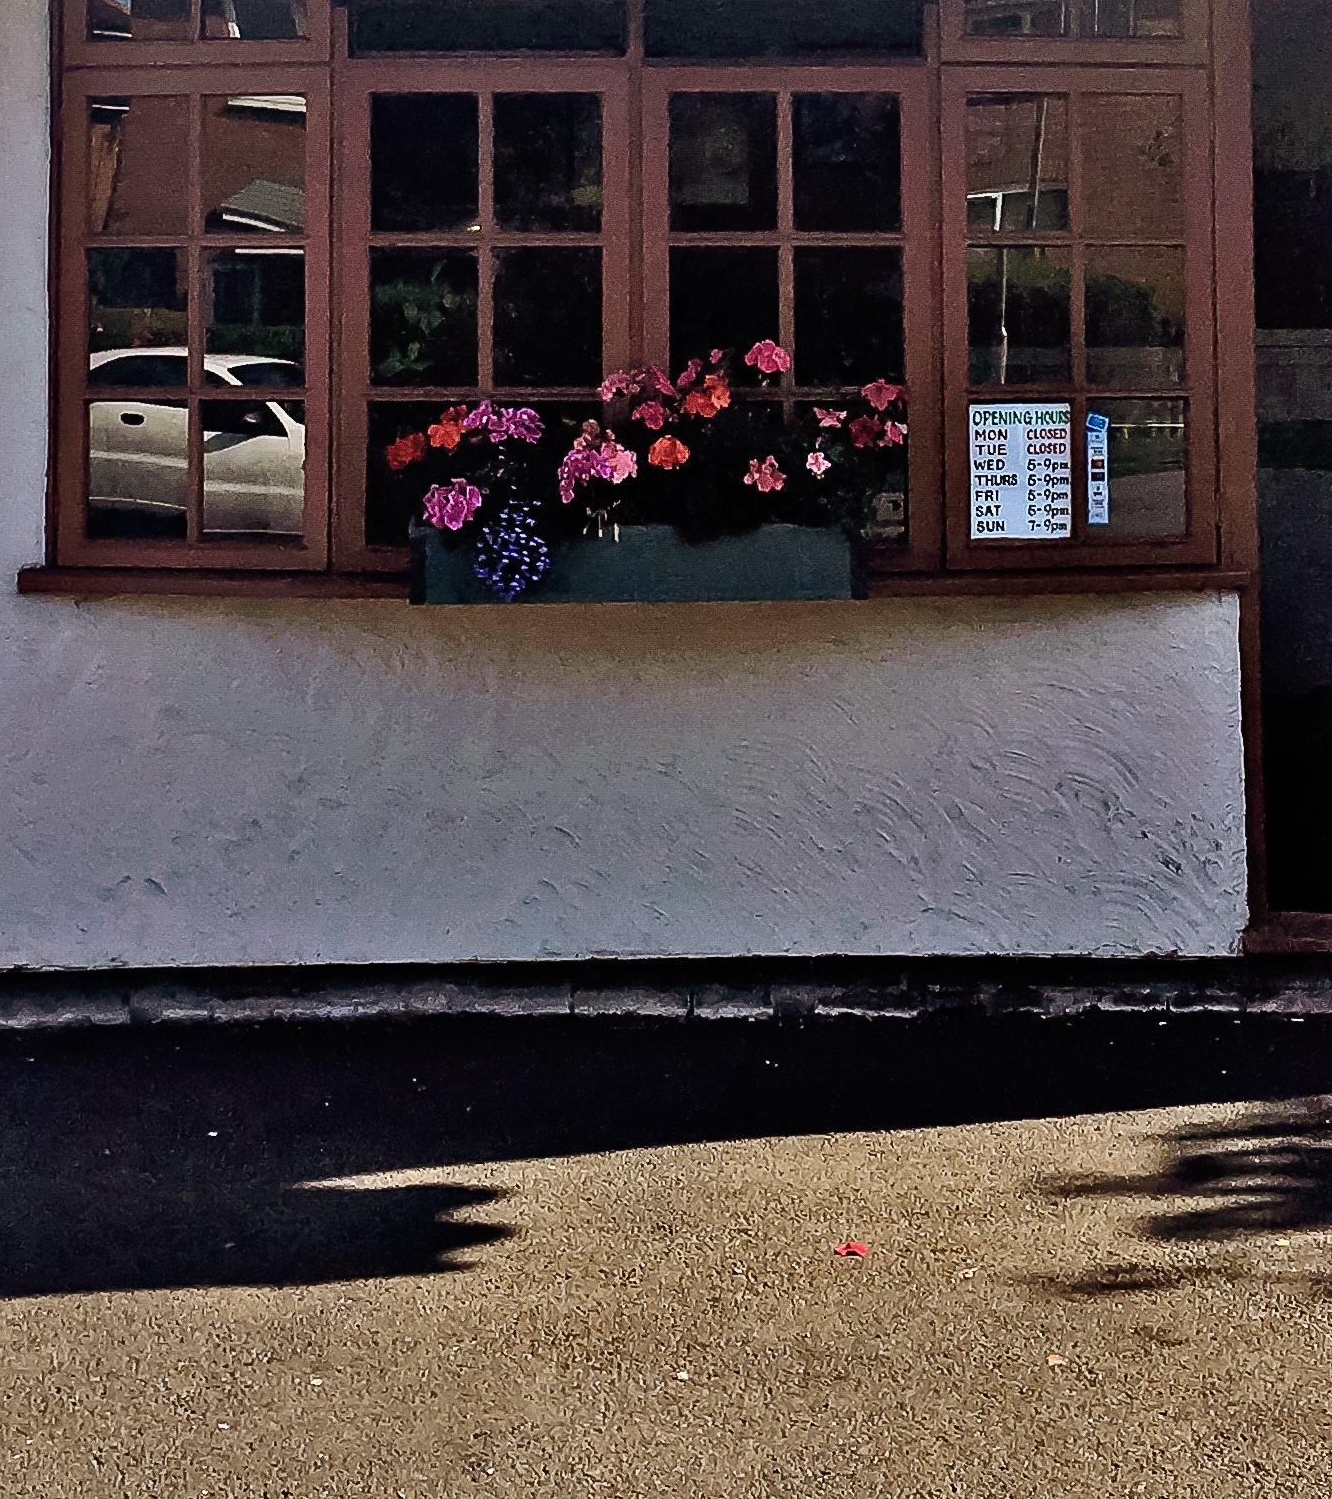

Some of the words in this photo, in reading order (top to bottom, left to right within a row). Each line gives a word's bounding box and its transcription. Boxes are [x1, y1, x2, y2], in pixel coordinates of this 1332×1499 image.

[973, 411, 1033, 425] OPENING
[1035, 410, 1070, 425] HOURS
[975, 429, 1008, 441] MON
[1026, 429, 1067, 440] CLOSED
[975, 444, 1007, 455] TUE
[1026, 443, 1067, 455] CLOSED
[974, 459, 1005, 470] WED
[975, 474, 1018, 486] THURS
[975, 490, 999, 501] FRI
[975, 505, 1001, 517] SAT
[976, 521, 1005, 533] SUN
[1028, 519, 1067, 533] 7-9pm
